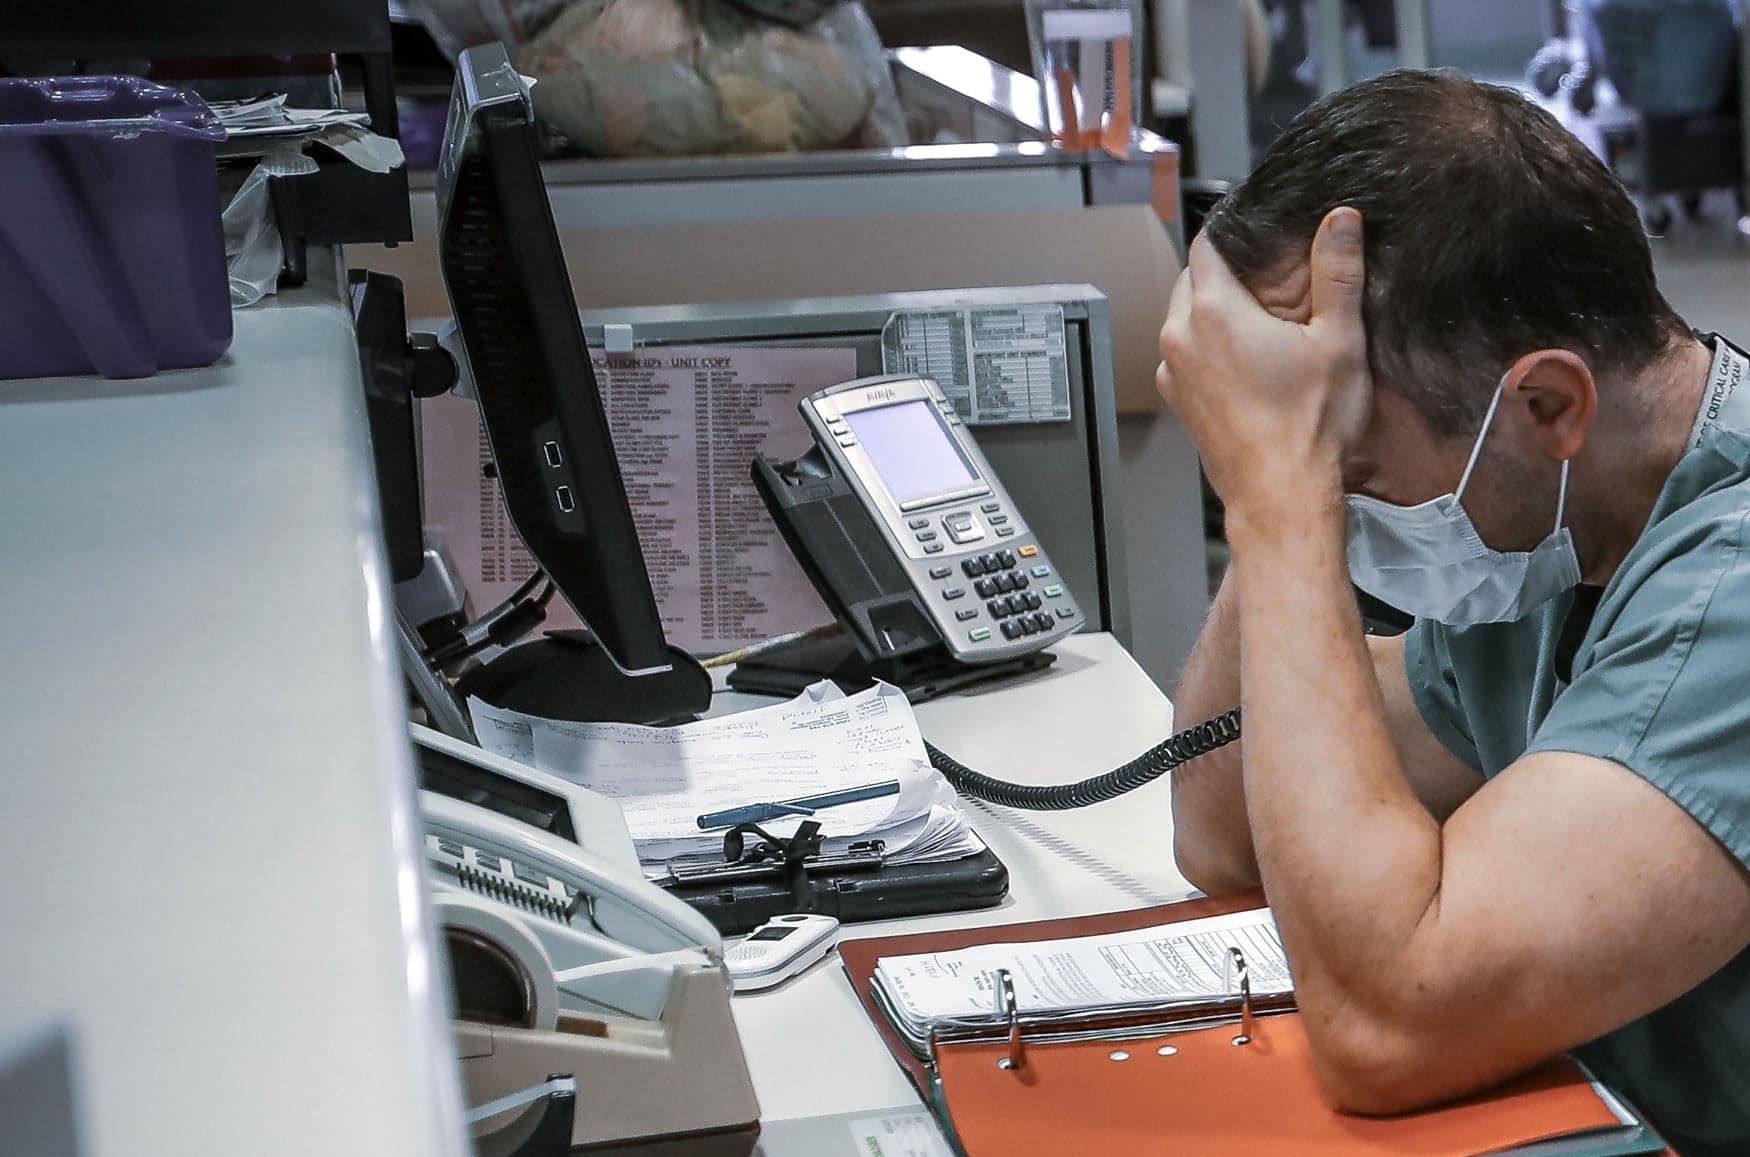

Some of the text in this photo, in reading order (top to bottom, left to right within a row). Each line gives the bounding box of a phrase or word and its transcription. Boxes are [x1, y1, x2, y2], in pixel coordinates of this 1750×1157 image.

[671, 357, 698, 368] UNIT
[701, 357, 731, 368] COPY
[1707, 379, 1726, 419] CRITICAL
